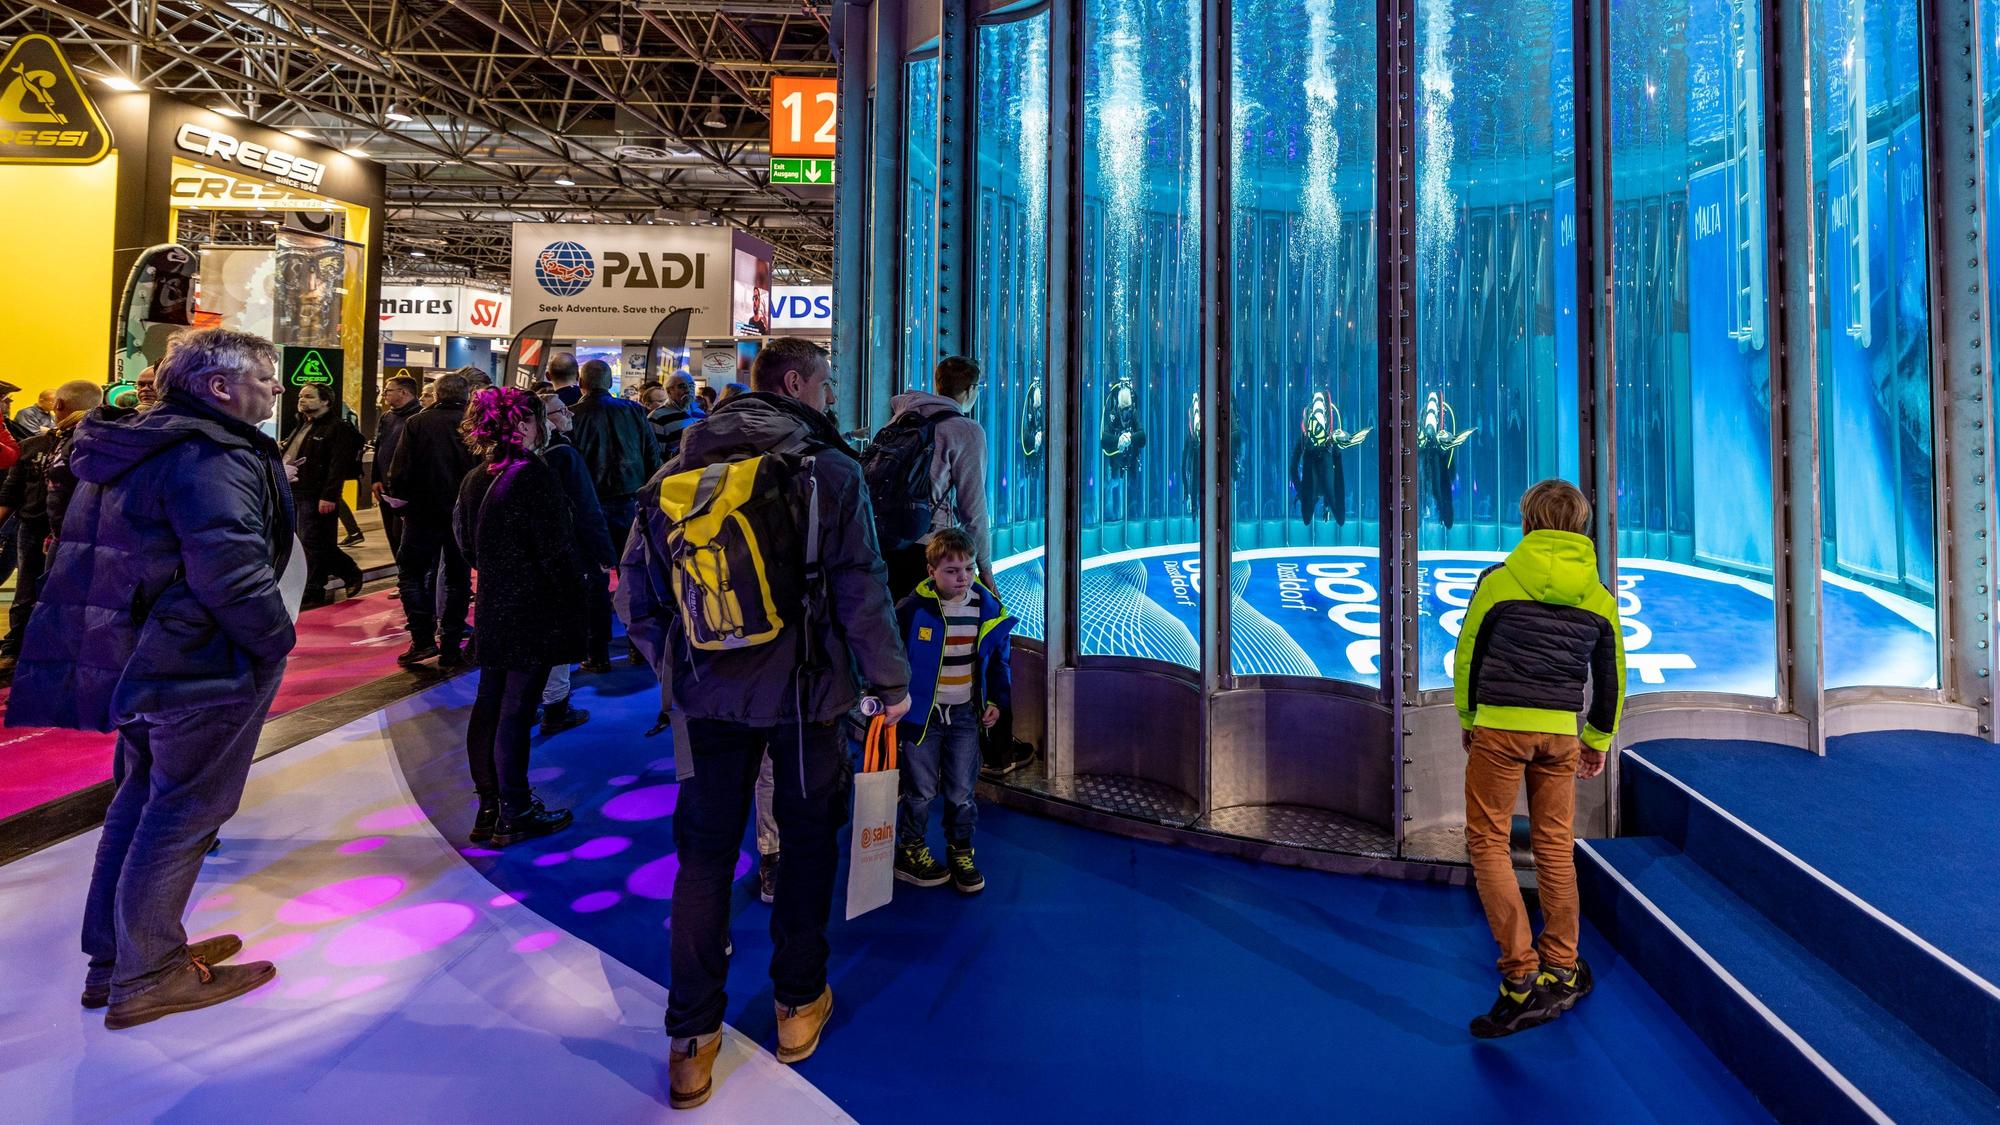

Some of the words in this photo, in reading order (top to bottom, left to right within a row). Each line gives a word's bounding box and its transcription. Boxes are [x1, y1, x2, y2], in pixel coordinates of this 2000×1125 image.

[781, 91, 837, 142] 12
[176, 123, 326, 186] CRESSI
[275, 176, 299, 188] SINCE
[1694, 201, 1721, 240] MALTA
[602, 251, 705, 289] PADI
[380, 298, 452, 314] mares
[470, 298, 502, 328] SSI
[539, 304, 563, 313] Seek
[566, 304, 620, 313] Adventure.
[622, 305, 647, 314] Save
[649, 305, 666, 314] the
[668, 305, 704, 315] Oan.
[771, 295, 831, 318] VDS
